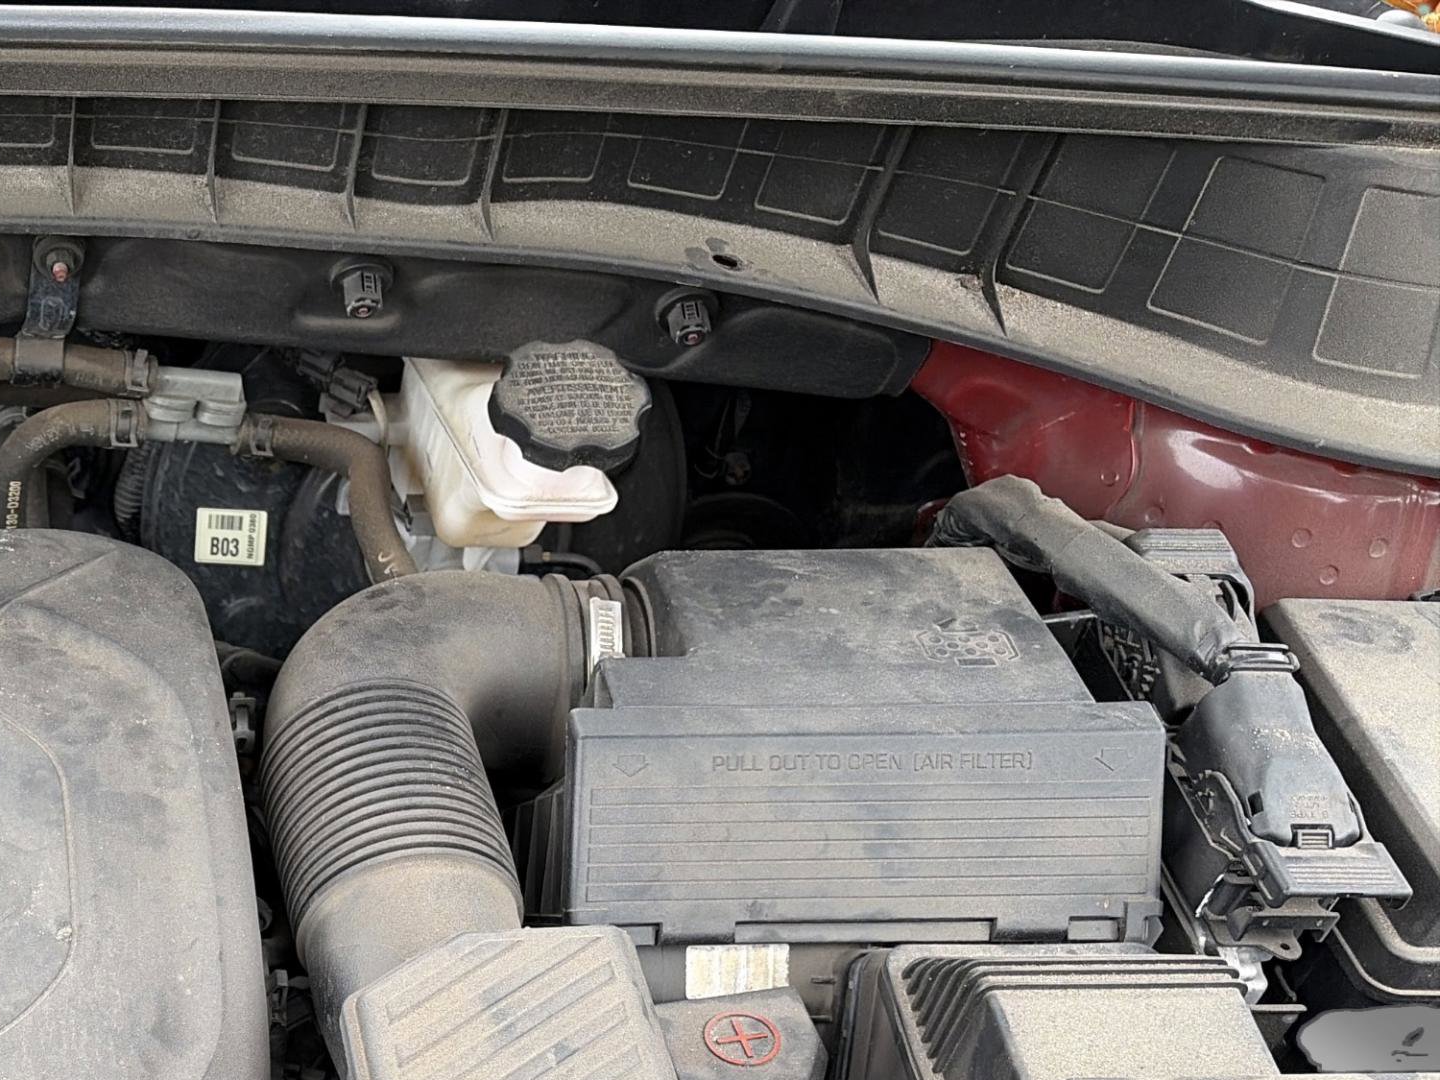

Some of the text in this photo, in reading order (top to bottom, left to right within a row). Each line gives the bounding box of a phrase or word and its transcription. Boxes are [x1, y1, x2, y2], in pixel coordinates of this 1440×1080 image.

[210, 537, 240, 557] B03
[712, 755, 764, 772] PULL
[769, 754, 810, 771] OUT
[816, 754, 841, 770] TO
[847, 753, 903, 770] OPEN
